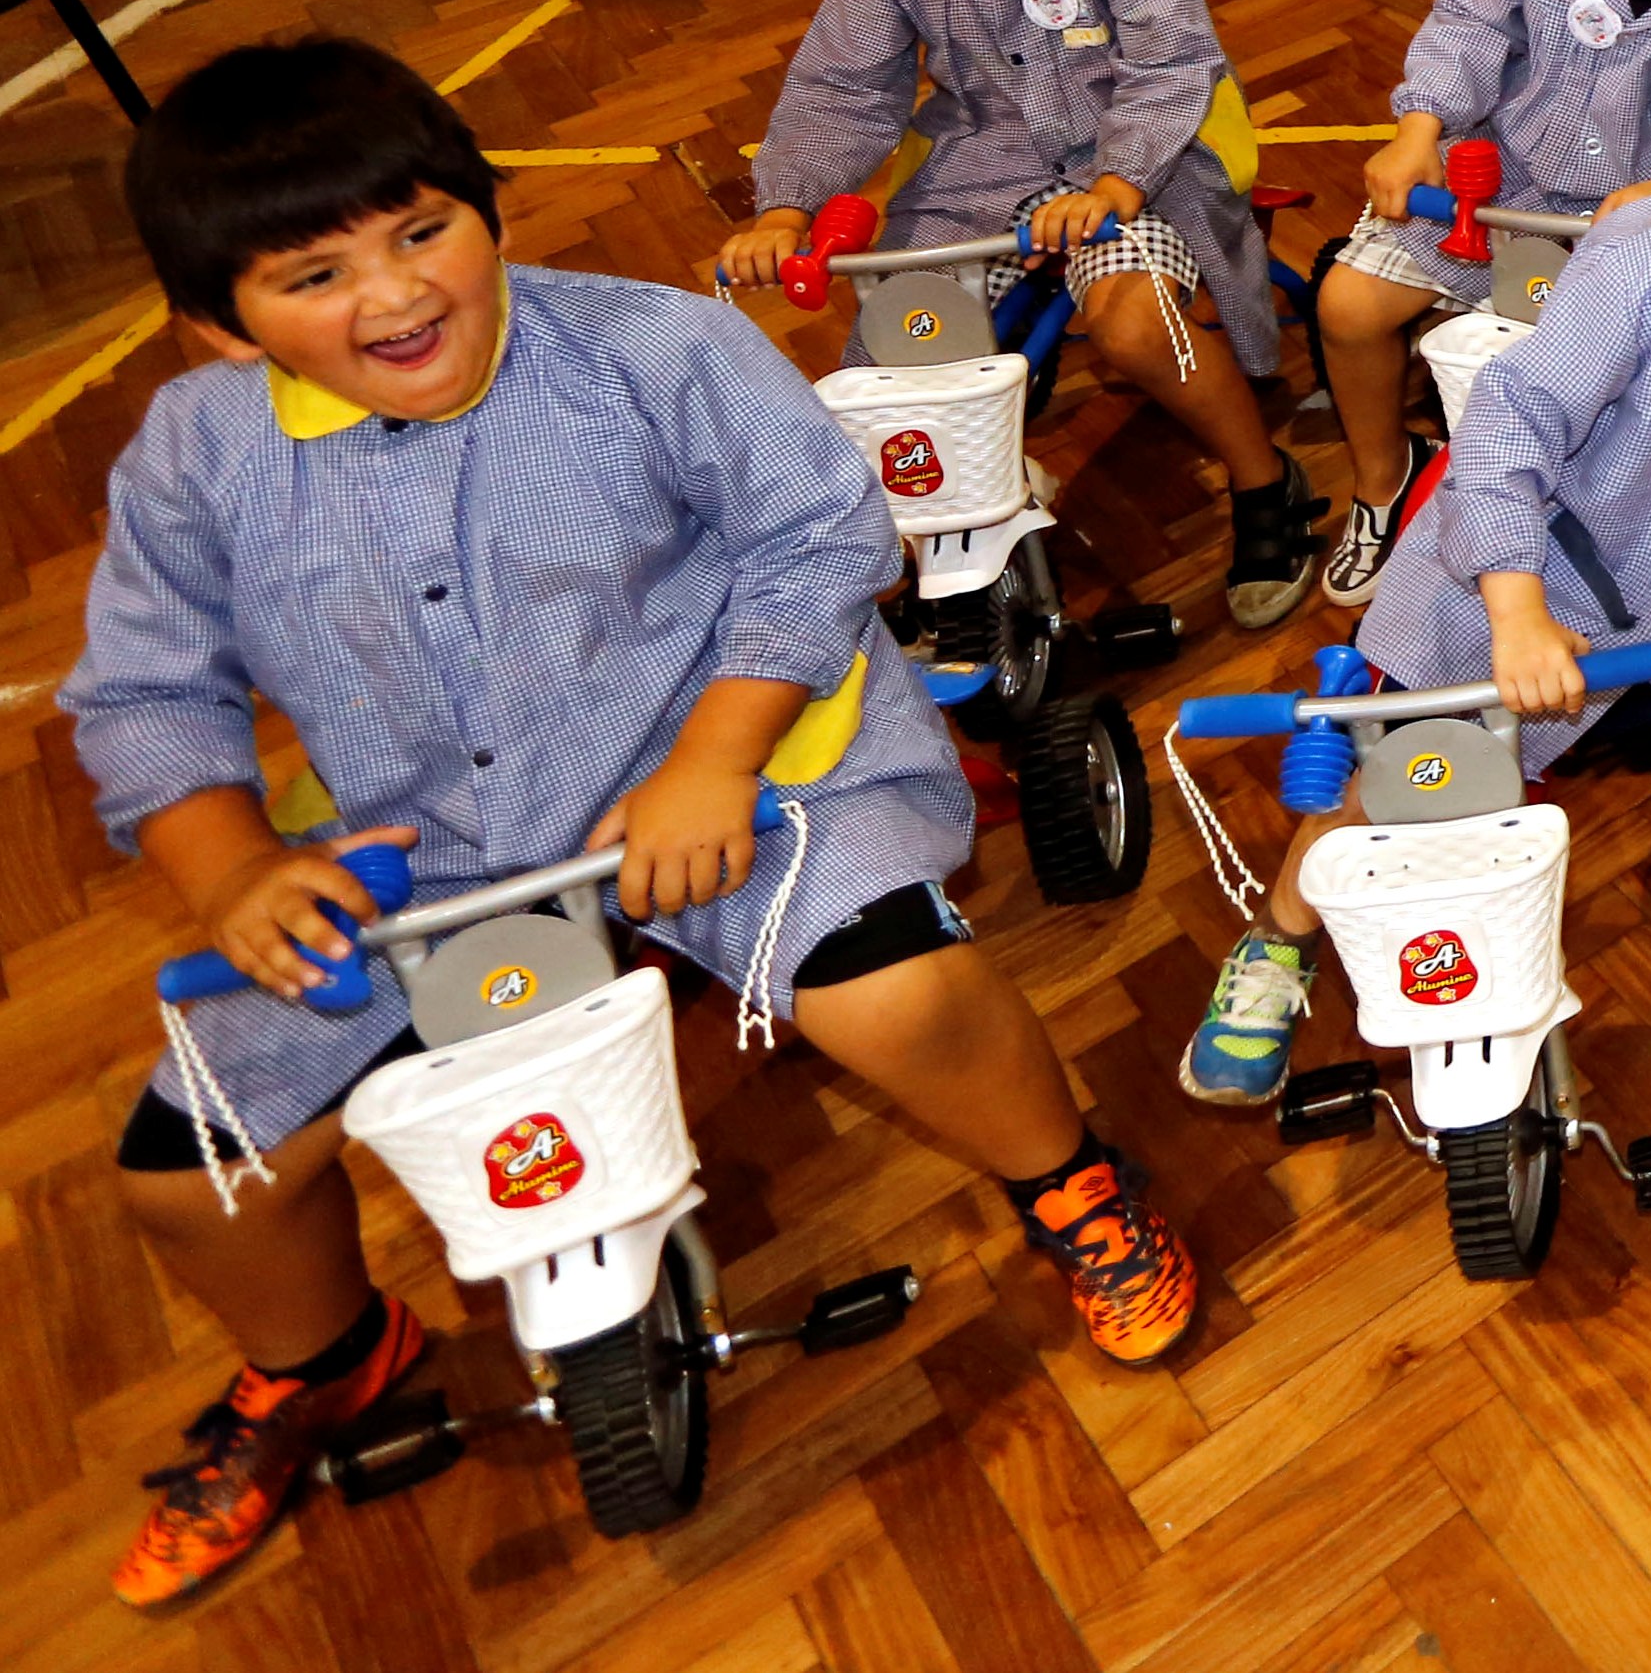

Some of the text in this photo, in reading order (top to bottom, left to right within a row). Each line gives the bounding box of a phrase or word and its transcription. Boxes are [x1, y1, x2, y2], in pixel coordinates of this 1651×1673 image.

[1412, 940, 1466, 977] A
[1407, 972, 1475, 995] Alumine
[504, 1124, 569, 1178] A
[499, 1160, 582, 1203] Alumine
